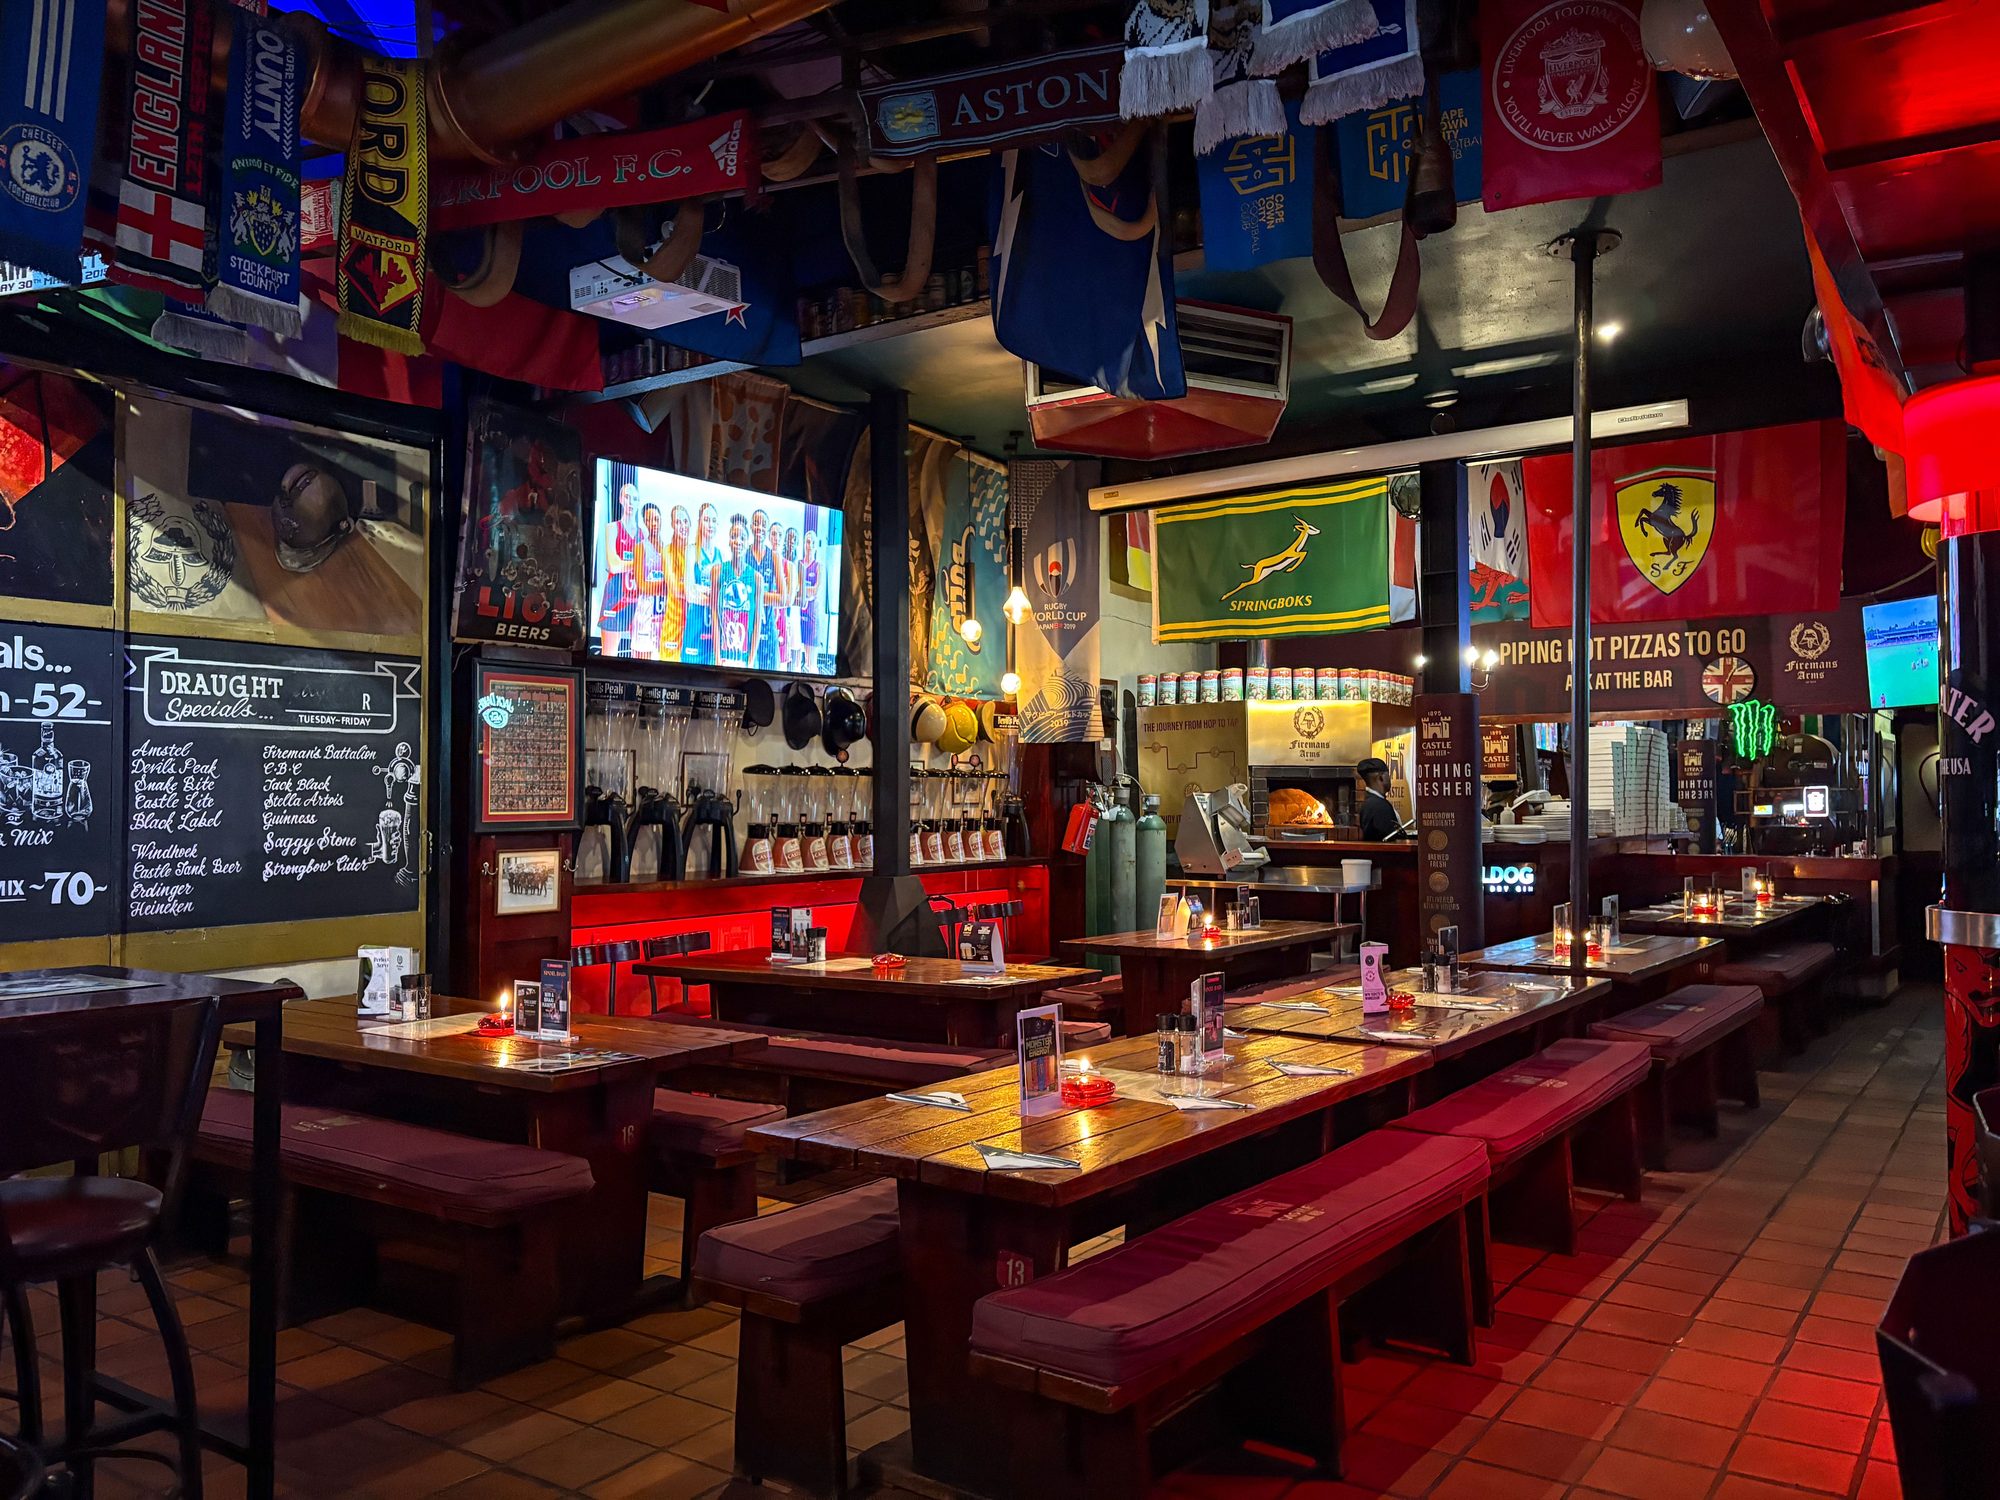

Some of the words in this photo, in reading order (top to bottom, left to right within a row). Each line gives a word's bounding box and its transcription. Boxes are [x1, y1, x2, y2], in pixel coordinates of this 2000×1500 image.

[1503, 16, 1551, 74] LIVERPOOL
[254, 28, 286, 143] OUNTY
[951, 68, 1110, 127] ASTON
[1440, 107, 1464, 122] APE
[1504, 96, 1531, 134] YOU'LL
[1532, 127, 1575, 143] NEVER
[1577, 115, 1617, 141] WALK
[1616, 78, 1643, 118] ALONE
[1440, 117, 1468, 131] OWN
[356, 66, 408, 207] ORD
[1441, 129, 1460, 144] ITY
[726, 118, 745, 178] adidas
[432, 155, 602, 207] RPOOL
[612, 148, 695, 186] F.C.
[1257, 197, 1266, 223] CITY
[1266, 194, 1275, 230] TOWN
[1274, 193, 1285, 224] CAPE
[354, 226, 412, 254] WATFORD
[229, 255, 290, 286] STOCKPORT
[239, 270, 280, 295] COUNTY
[1650, 562, 1662, 578] S
[1673, 560, 1693, 576] F
[1044, 602, 1068, 611] RUGBY
[1229, 595, 1313, 612] SPRINGBOKS
[1066, 611, 1087, 621] CUP
[495, 623, 551, 641] BEERS
[1499, 639, 1562, 666] PIPING
[1610, 632, 1680, 660] PIZZAS
[1684, 630, 1712, 656] TO
[1716, 628, 1746, 654] GO
[1784, 660, 1838, 672] Firemans
[1796, 671, 1825, 680] Arms
[160, 670, 284, 699] DRAUGHT
[604, 682, 624, 696] Peak
[1565, 673, 1594, 692] AK
[1595, 672, 1613, 690] AT
[1613, 671, 1640, 689] THE
[1644, 669, 1673, 688] BAR
[362, 692, 372, 711] R
[662, 688, 680, 701] Peak
[717, 693, 736, 706] Peak
[1050, 718, 1069, 728] 2019
[1143, 722, 1155, 733] THE
[1156, 721, 1184, 732] JOURNEY
[1184, 719, 1202, 730] FROM
[1203, 719, 1216, 729] HOP
[1218, 718, 1226, 728] TO
[131, 739, 194, 757] Amstel
[323, 743, 377, 761] Battalion
[1299, 749, 1320, 758] Arms
[1421, 741, 1452, 750] CASTLE
[178, 757, 221, 779] Peak
[1483, 755, 1510, 763] CASTLE
[1950, 757, 1972, 776] USA
[1418, 762, 1473, 778] OTHING
[134, 773, 178, 794] Snake
[183, 775, 215, 793] Bite
[262, 777, 293, 792] Jack
[295, 775, 332, 792] Black
[1388, 786, 1404, 798] ASTLE
[1418, 781, 1473, 798] RESHER
[134, 792, 180, 810] Castle
[183, 791, 215, 812] Lite
[263, 791, 302, 810] Stella
[303, 791, 344, 807] Artois
[129, 811, 177, 834] Black
[177, 809, 224, 832] Label
[262, 809, 318, 831] Guinness
[10, 828, 54, 847] Mix
[263, 831, 315, 857] Saggy
[316, 826, 357, 850] Stone
[131, 840, 199, 860] Windhoek
[132, 861, 173, 880] Castle
[174, 857, 208, 877] Tank
[212, 857, 243, 875] Beer
[262, 858, 335, 882] Strongbow
[335, 854, 369, 872] Cider
[1482, 866, 1534, 885] LDOG
[130, 880, 194, 903] Erdinger
[130, 898, 195, 918] Heineken
[1699, 962, 1709, 975] 10
[1025, 1036, 1053, 1050] MONSTER
[1028, 1046, 1051, 1058] ENERGY
[622, 1124, 635, 1147] 16
[1006, 1258, 1025, 1287] 13
